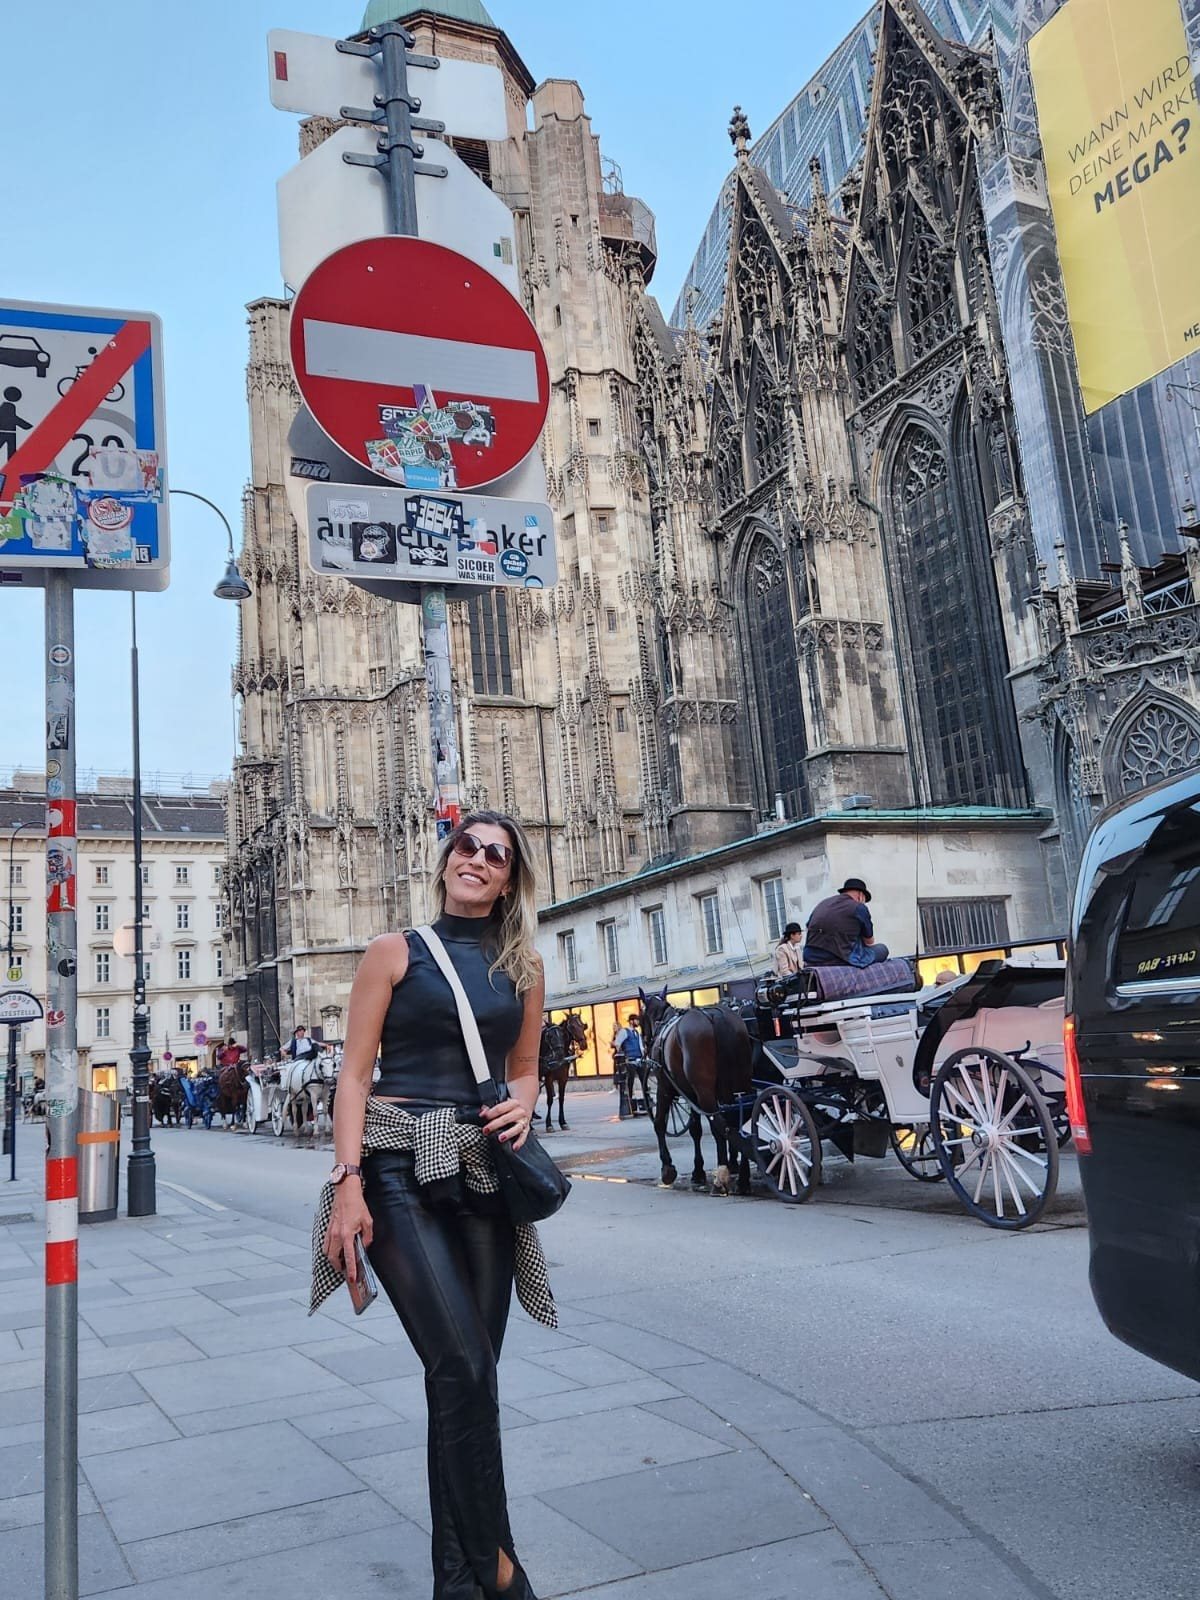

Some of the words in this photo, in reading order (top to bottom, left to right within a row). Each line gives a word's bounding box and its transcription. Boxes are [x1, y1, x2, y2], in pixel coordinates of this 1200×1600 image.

[1068, 103, 1128, 164] WANN
[1133, 55, 1190, 109] WIRD
[1069, 139, 1124, 195] DEINE
[1128, 81, 1198, 149] MARKE
[1093, 117, 1191, 213] MEGA?
[457, 558, 495, 573] SICOER
[458, 570, 476, 580] WAS
[477, 572, 495, 582] HERE
